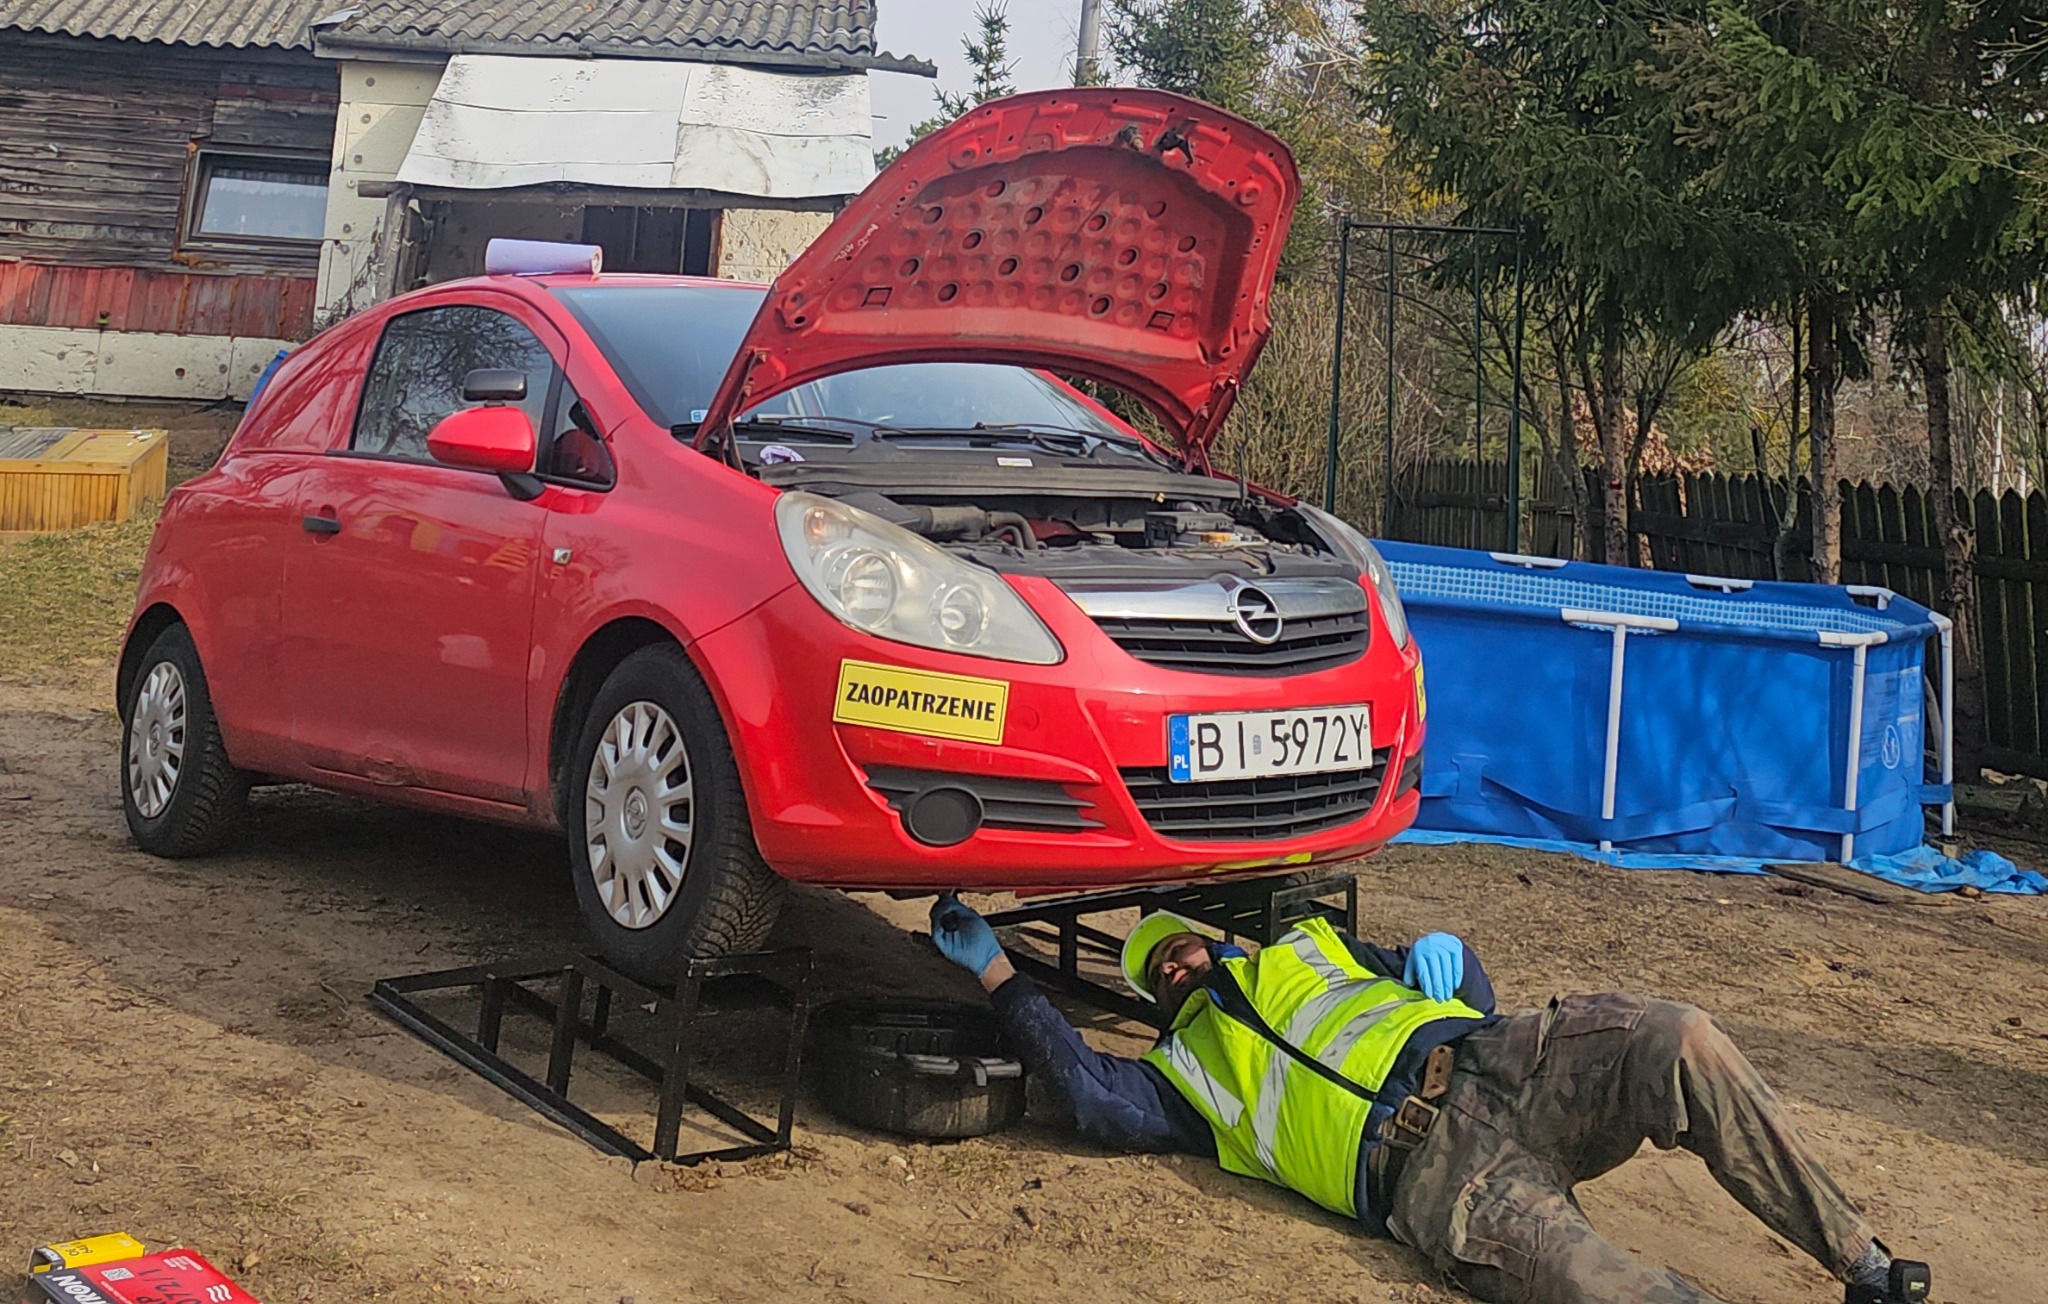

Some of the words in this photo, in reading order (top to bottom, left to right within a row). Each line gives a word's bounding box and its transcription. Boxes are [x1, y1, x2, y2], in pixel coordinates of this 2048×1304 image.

[846, 682, 997, 722] ZAOPATRZENIE
[1173, 755, 1188, 769] PL
[1197, 721, 1246, 772] BI
[1270, 713, 1364, 767] 5972Y
